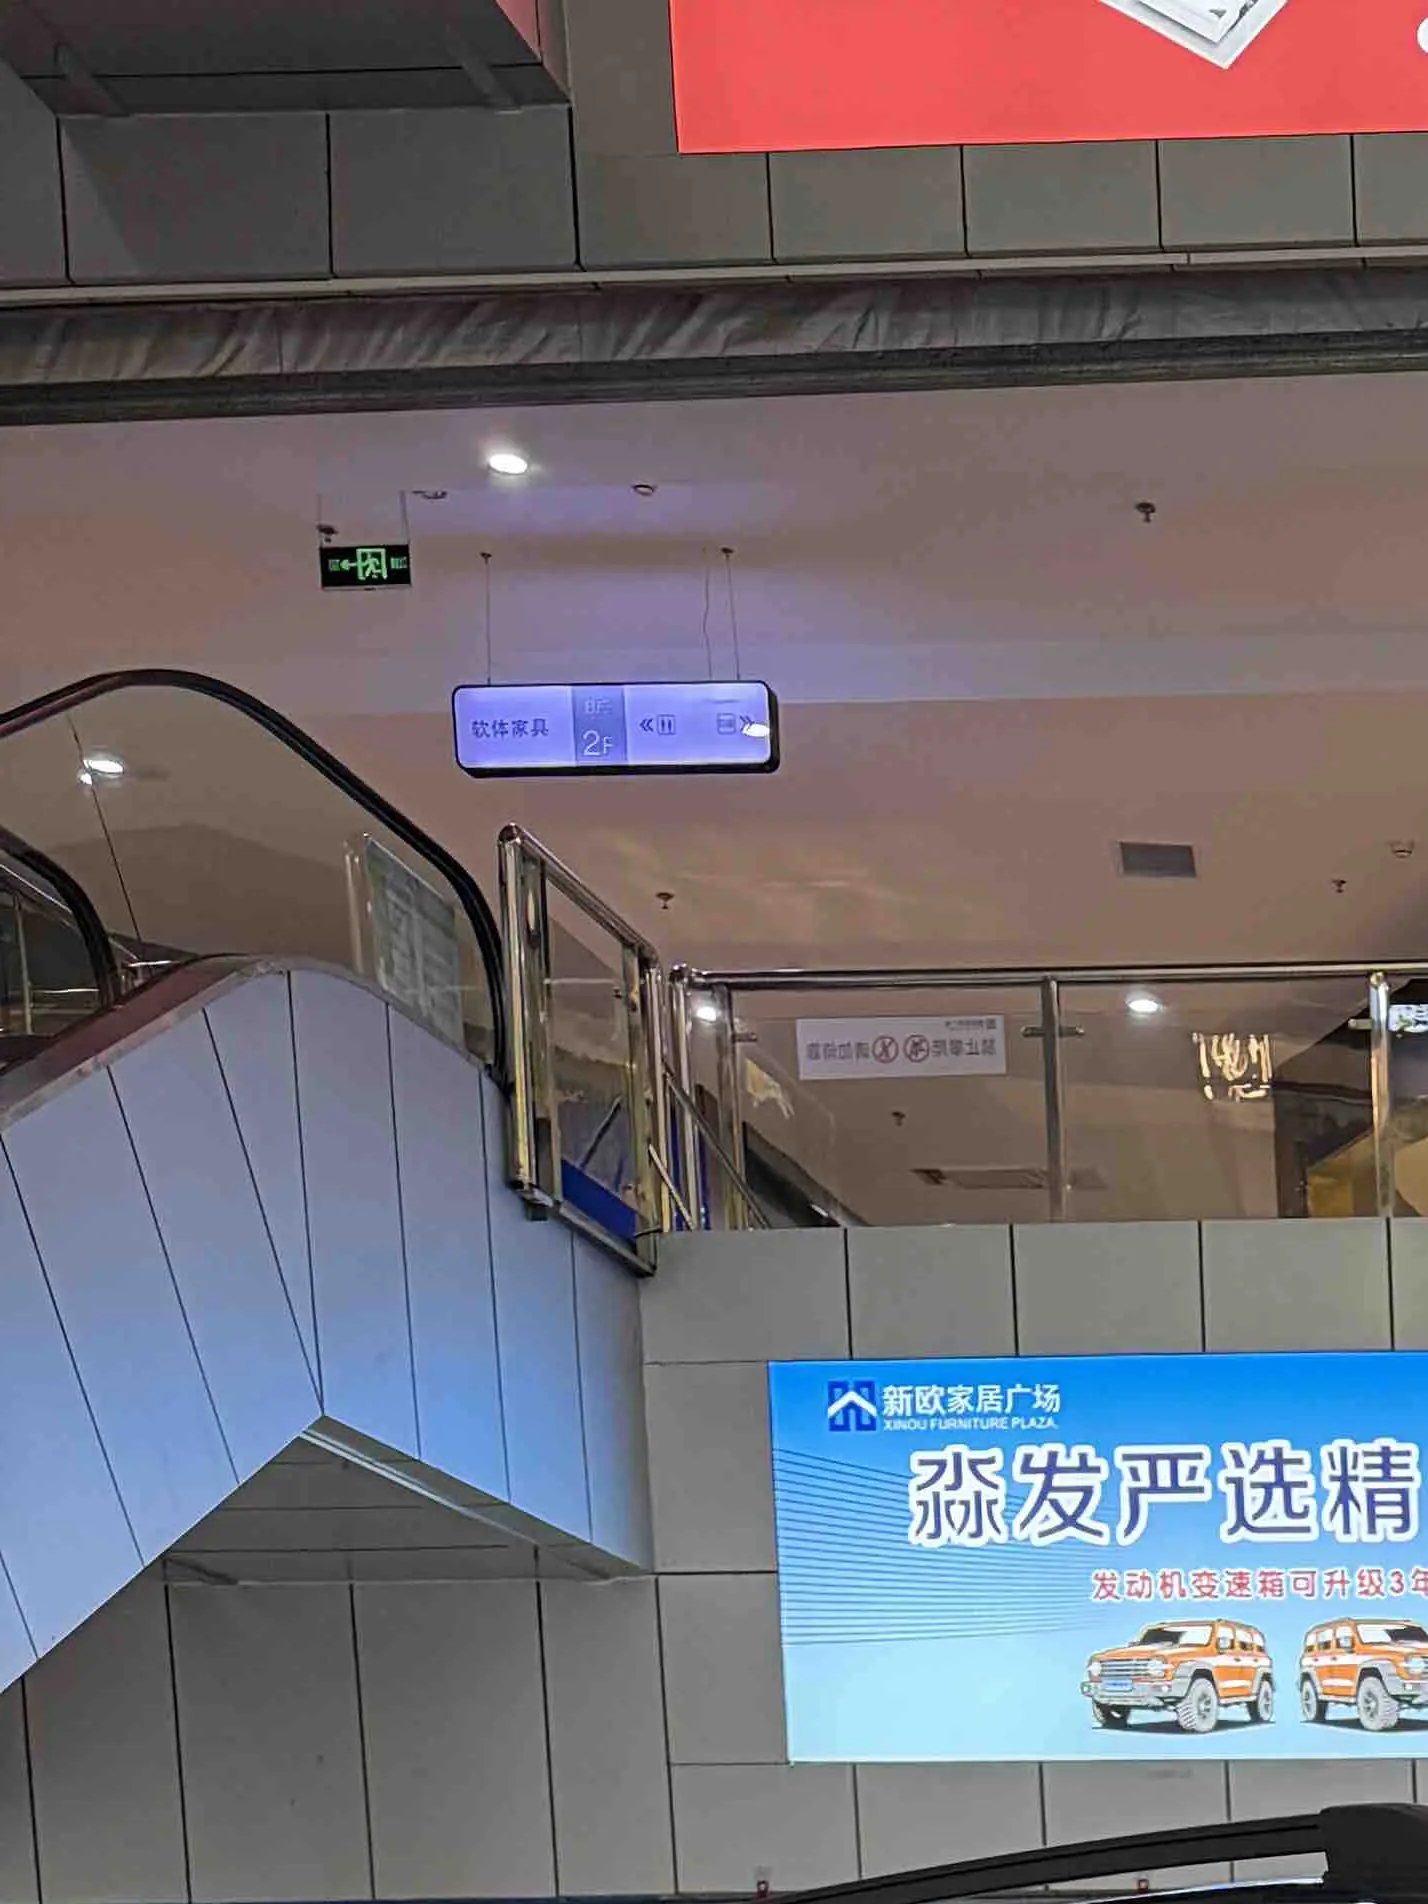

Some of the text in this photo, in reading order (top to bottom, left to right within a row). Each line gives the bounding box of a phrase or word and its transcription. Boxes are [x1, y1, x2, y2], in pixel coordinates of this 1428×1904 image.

[470, 718, 550, 739] 软体家具
[582, 729, 614, 757] 2F
[882, 1383, 1061, 1417] 新欧家居广场
[930, 1418, 1008, 1431] FURNITURE
